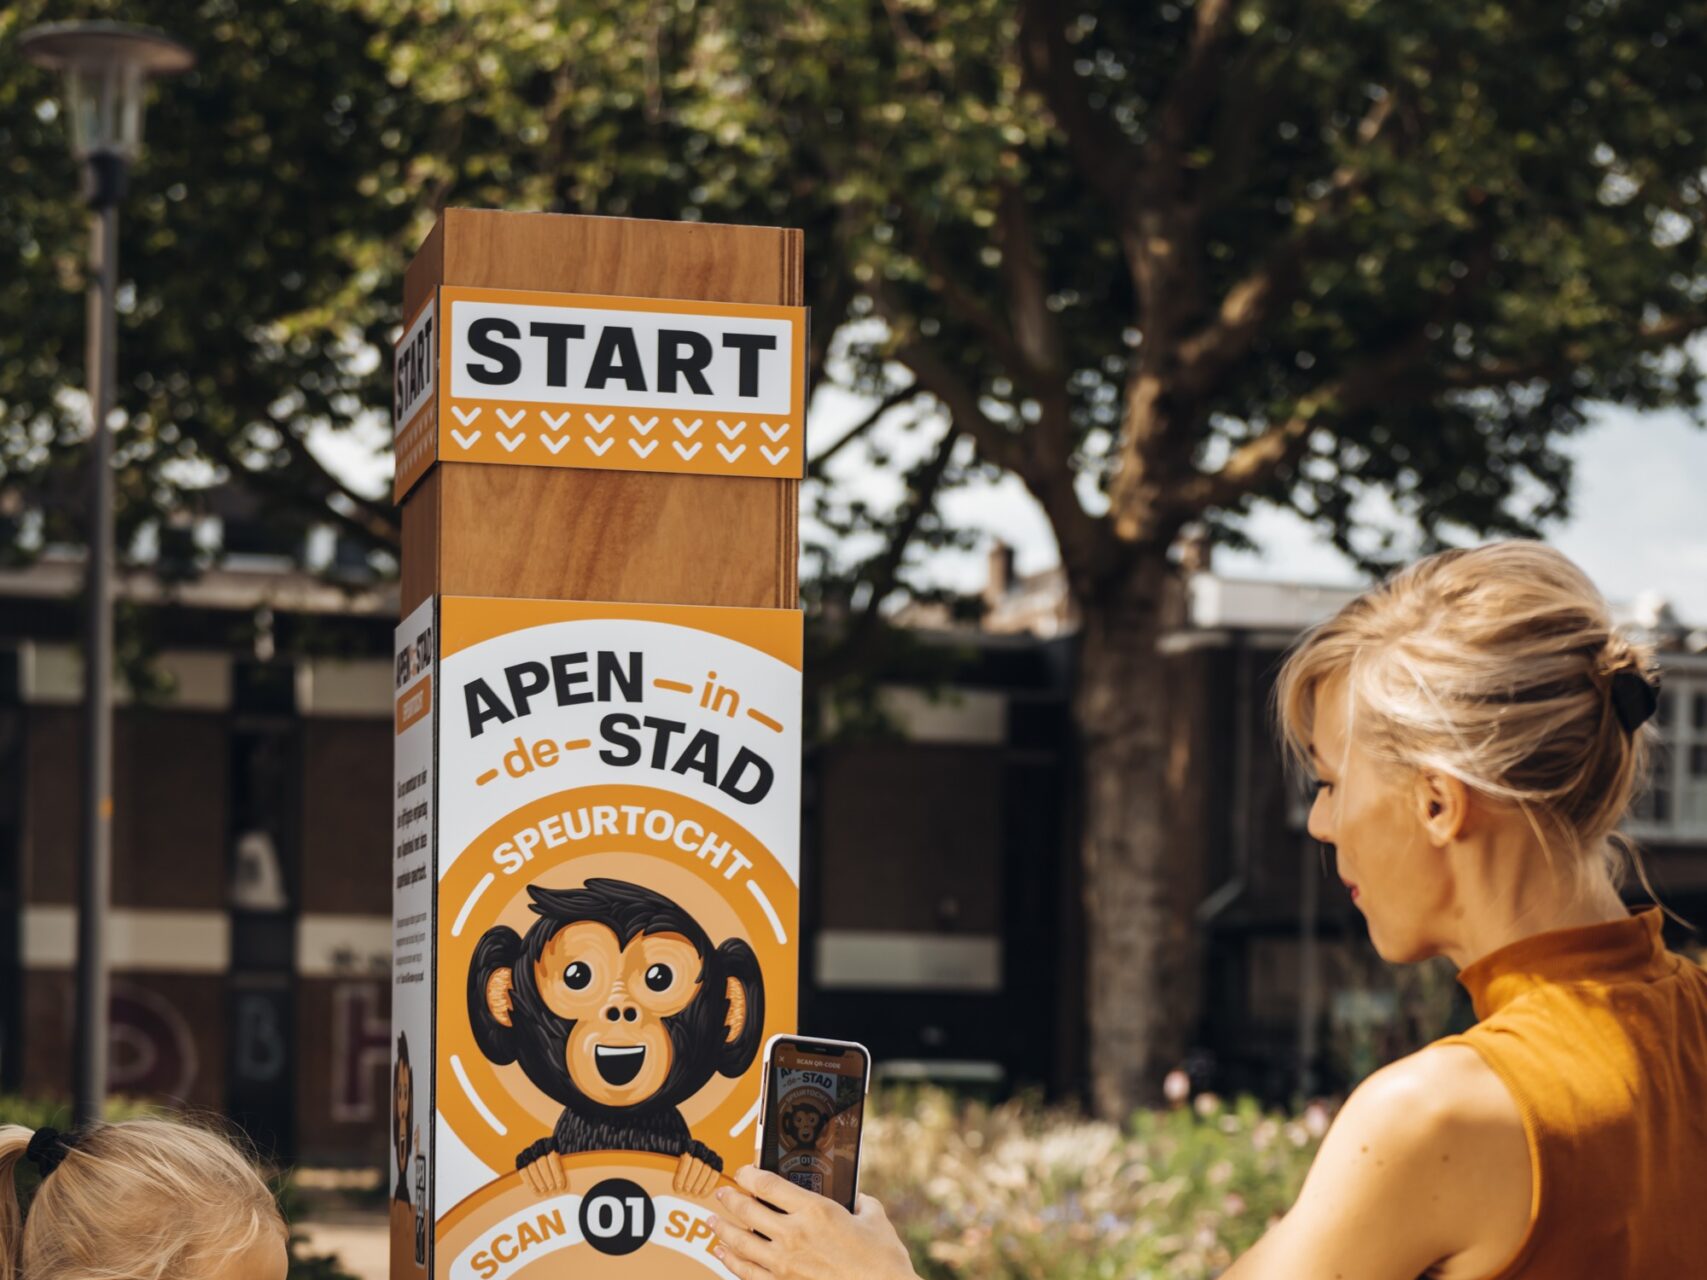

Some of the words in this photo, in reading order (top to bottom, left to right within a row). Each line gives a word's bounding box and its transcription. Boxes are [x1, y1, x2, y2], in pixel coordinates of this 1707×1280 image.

[398, 317, 432, 421] START
[466, 317, 777, 398] START
[463, 651, 643, 739] APEN
[599, 713, 775, 805] STAD
[493, 805, 753, 880] SPEURTOCHT
[802, 1072, 833, 1089] STAD
[470, 1209, 567, 1280] SCAN
[586, 1195, 645, 1239] 01
